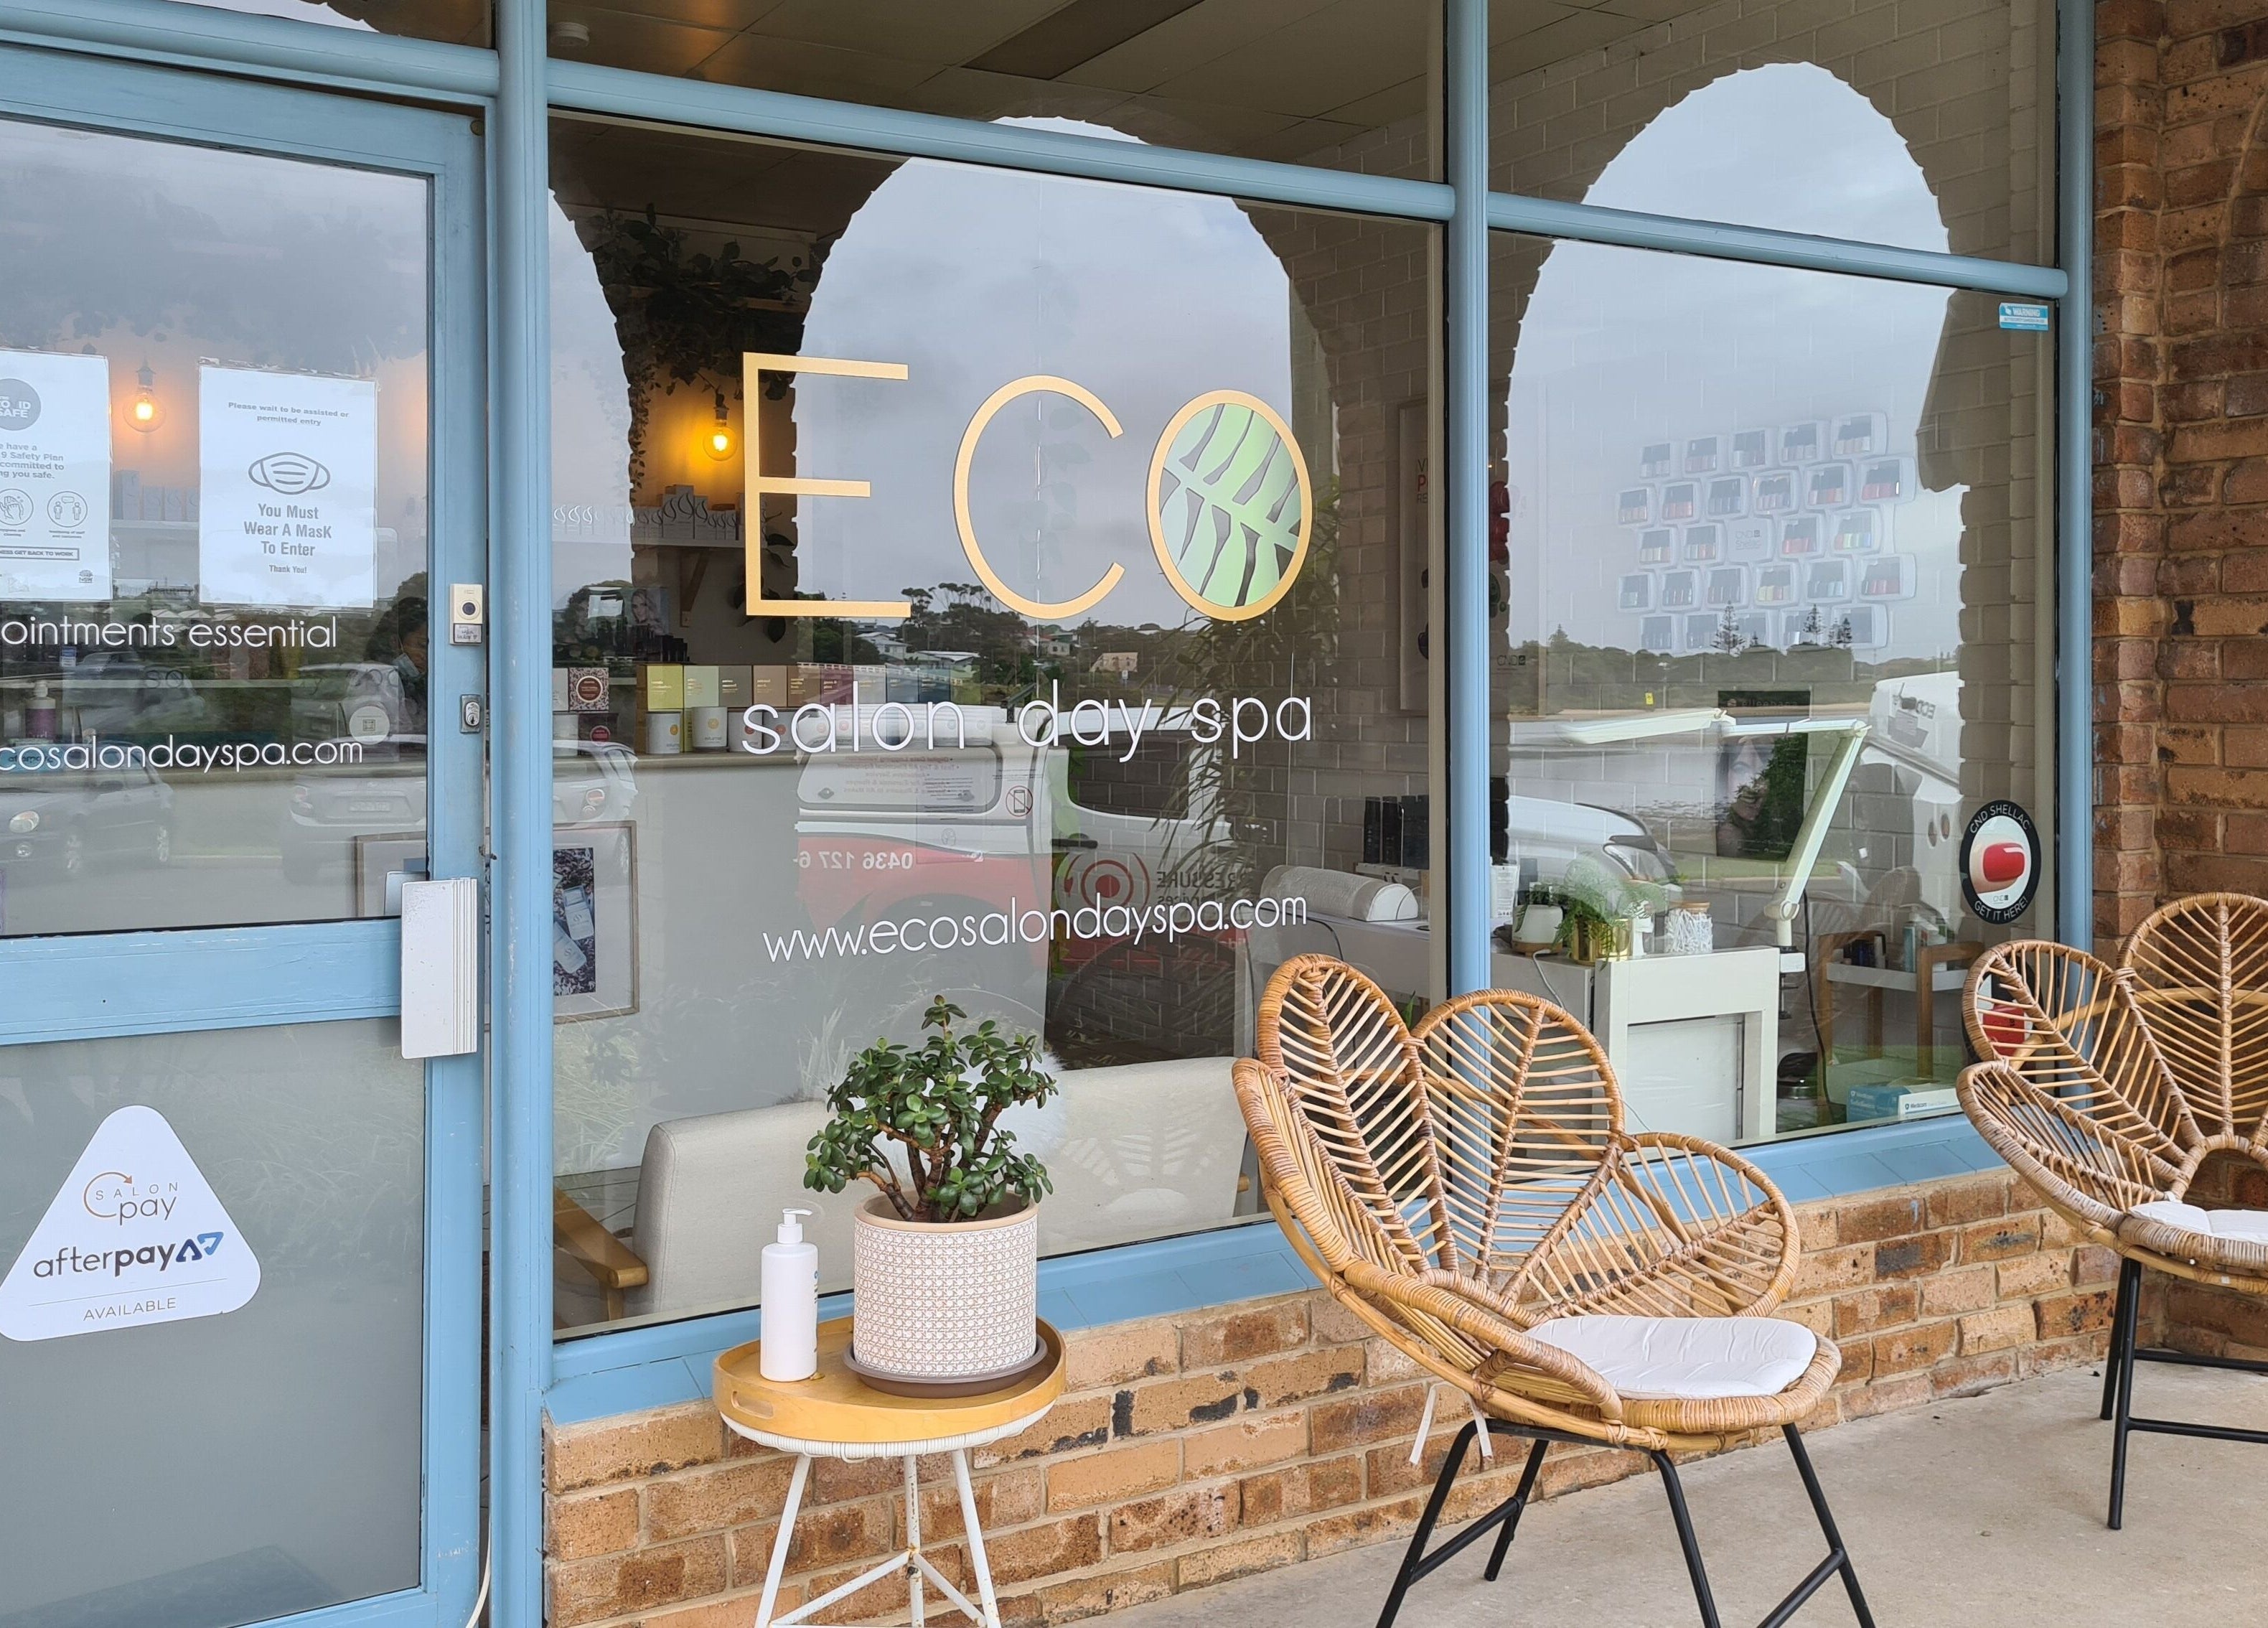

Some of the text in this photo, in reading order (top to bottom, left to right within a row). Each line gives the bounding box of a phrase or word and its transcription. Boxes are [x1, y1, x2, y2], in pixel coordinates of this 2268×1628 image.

[228, 402, 257, 411] Please
[257, 415, 298, 424] permitted
[6, 442, 29, 451] have
[10, 452, 41, 461] Safety
[0, 462, 52, 470] committed
[743, 352, 1312, 622] ECO
[258, 502, 319, 520] You Must
[244, 521, 332, 539] Wear A MasK
[261, 541, 316, 556] To Enter
[269, 564, 291, 573] Thank
[189, 615, 337, 647] essential
[741, 678, 1312, 762] salon day spa
[1969, 804, 2030, 833] CND SHELLAC
[1974, 896, 2029, 921] GET IT HERE!
[762, 893, 1308, 963] www.ecosalondayspa.com
[95, 1182, 178, 1200] SALON
[119, 1196, 177, 1225] pay
[34, 1243, 177, 1278] afterpay
[83, 1297, 177, 1321] AVAILABLE
